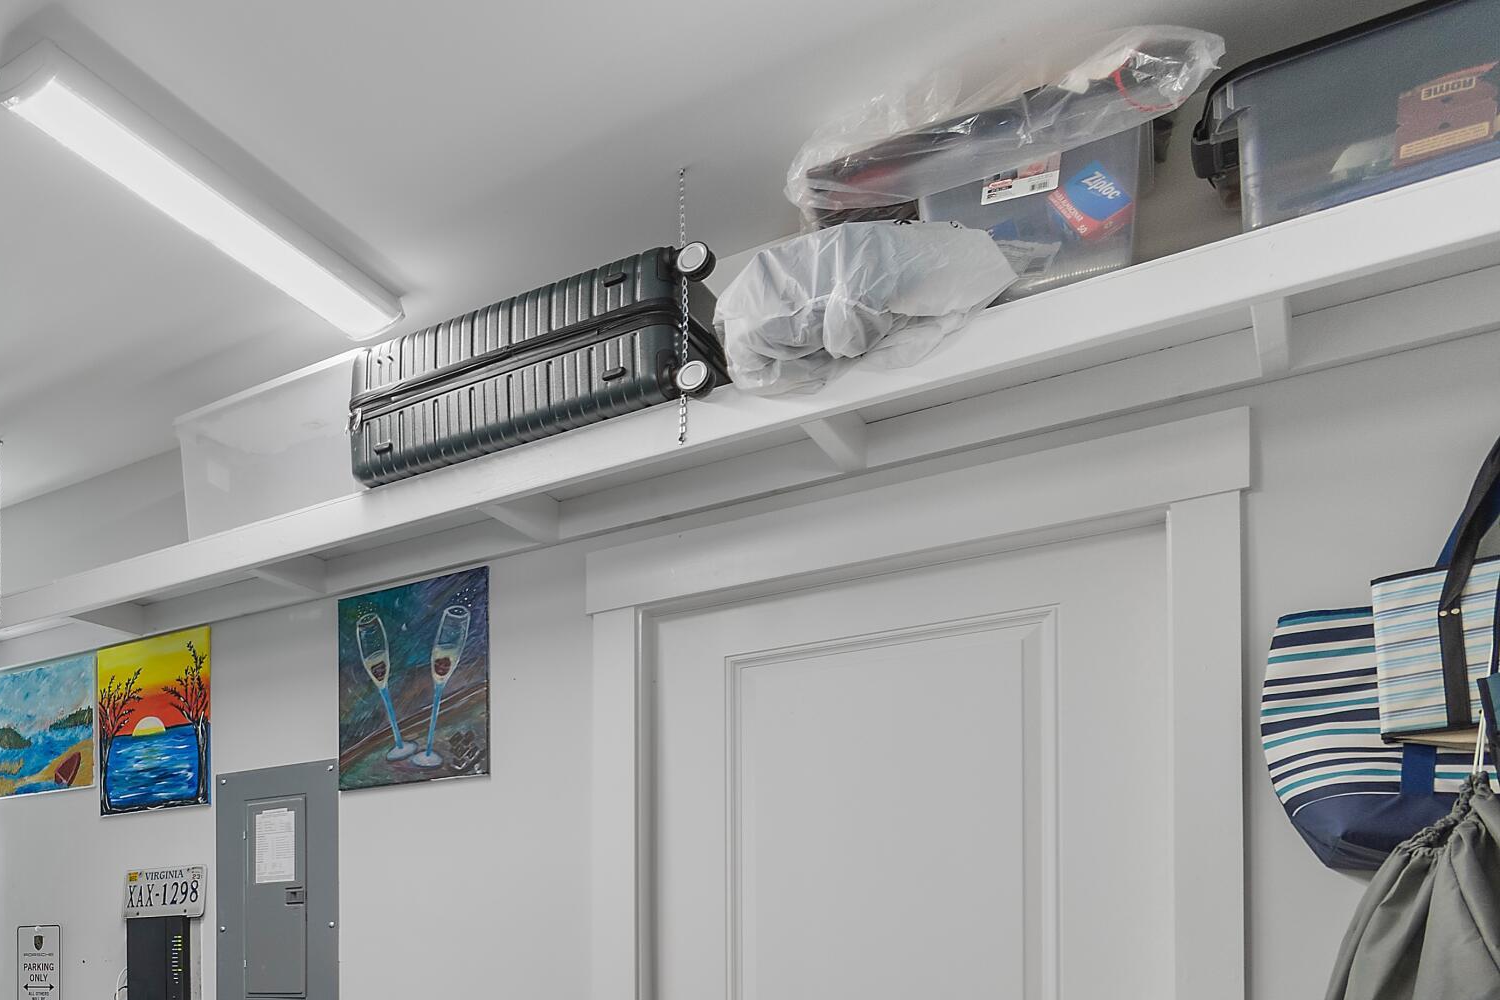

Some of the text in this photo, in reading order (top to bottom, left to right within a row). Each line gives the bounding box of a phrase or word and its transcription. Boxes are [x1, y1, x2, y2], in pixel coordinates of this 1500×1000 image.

[1081, 171, 1121, 200] Ziploc
[145, 870, 184, 881] VIRGINIA
[127, 880, 199, 908] XAX-1298
[23, 963, 54, 971] PARKING
[29, 974, 48, 982] ONLY
